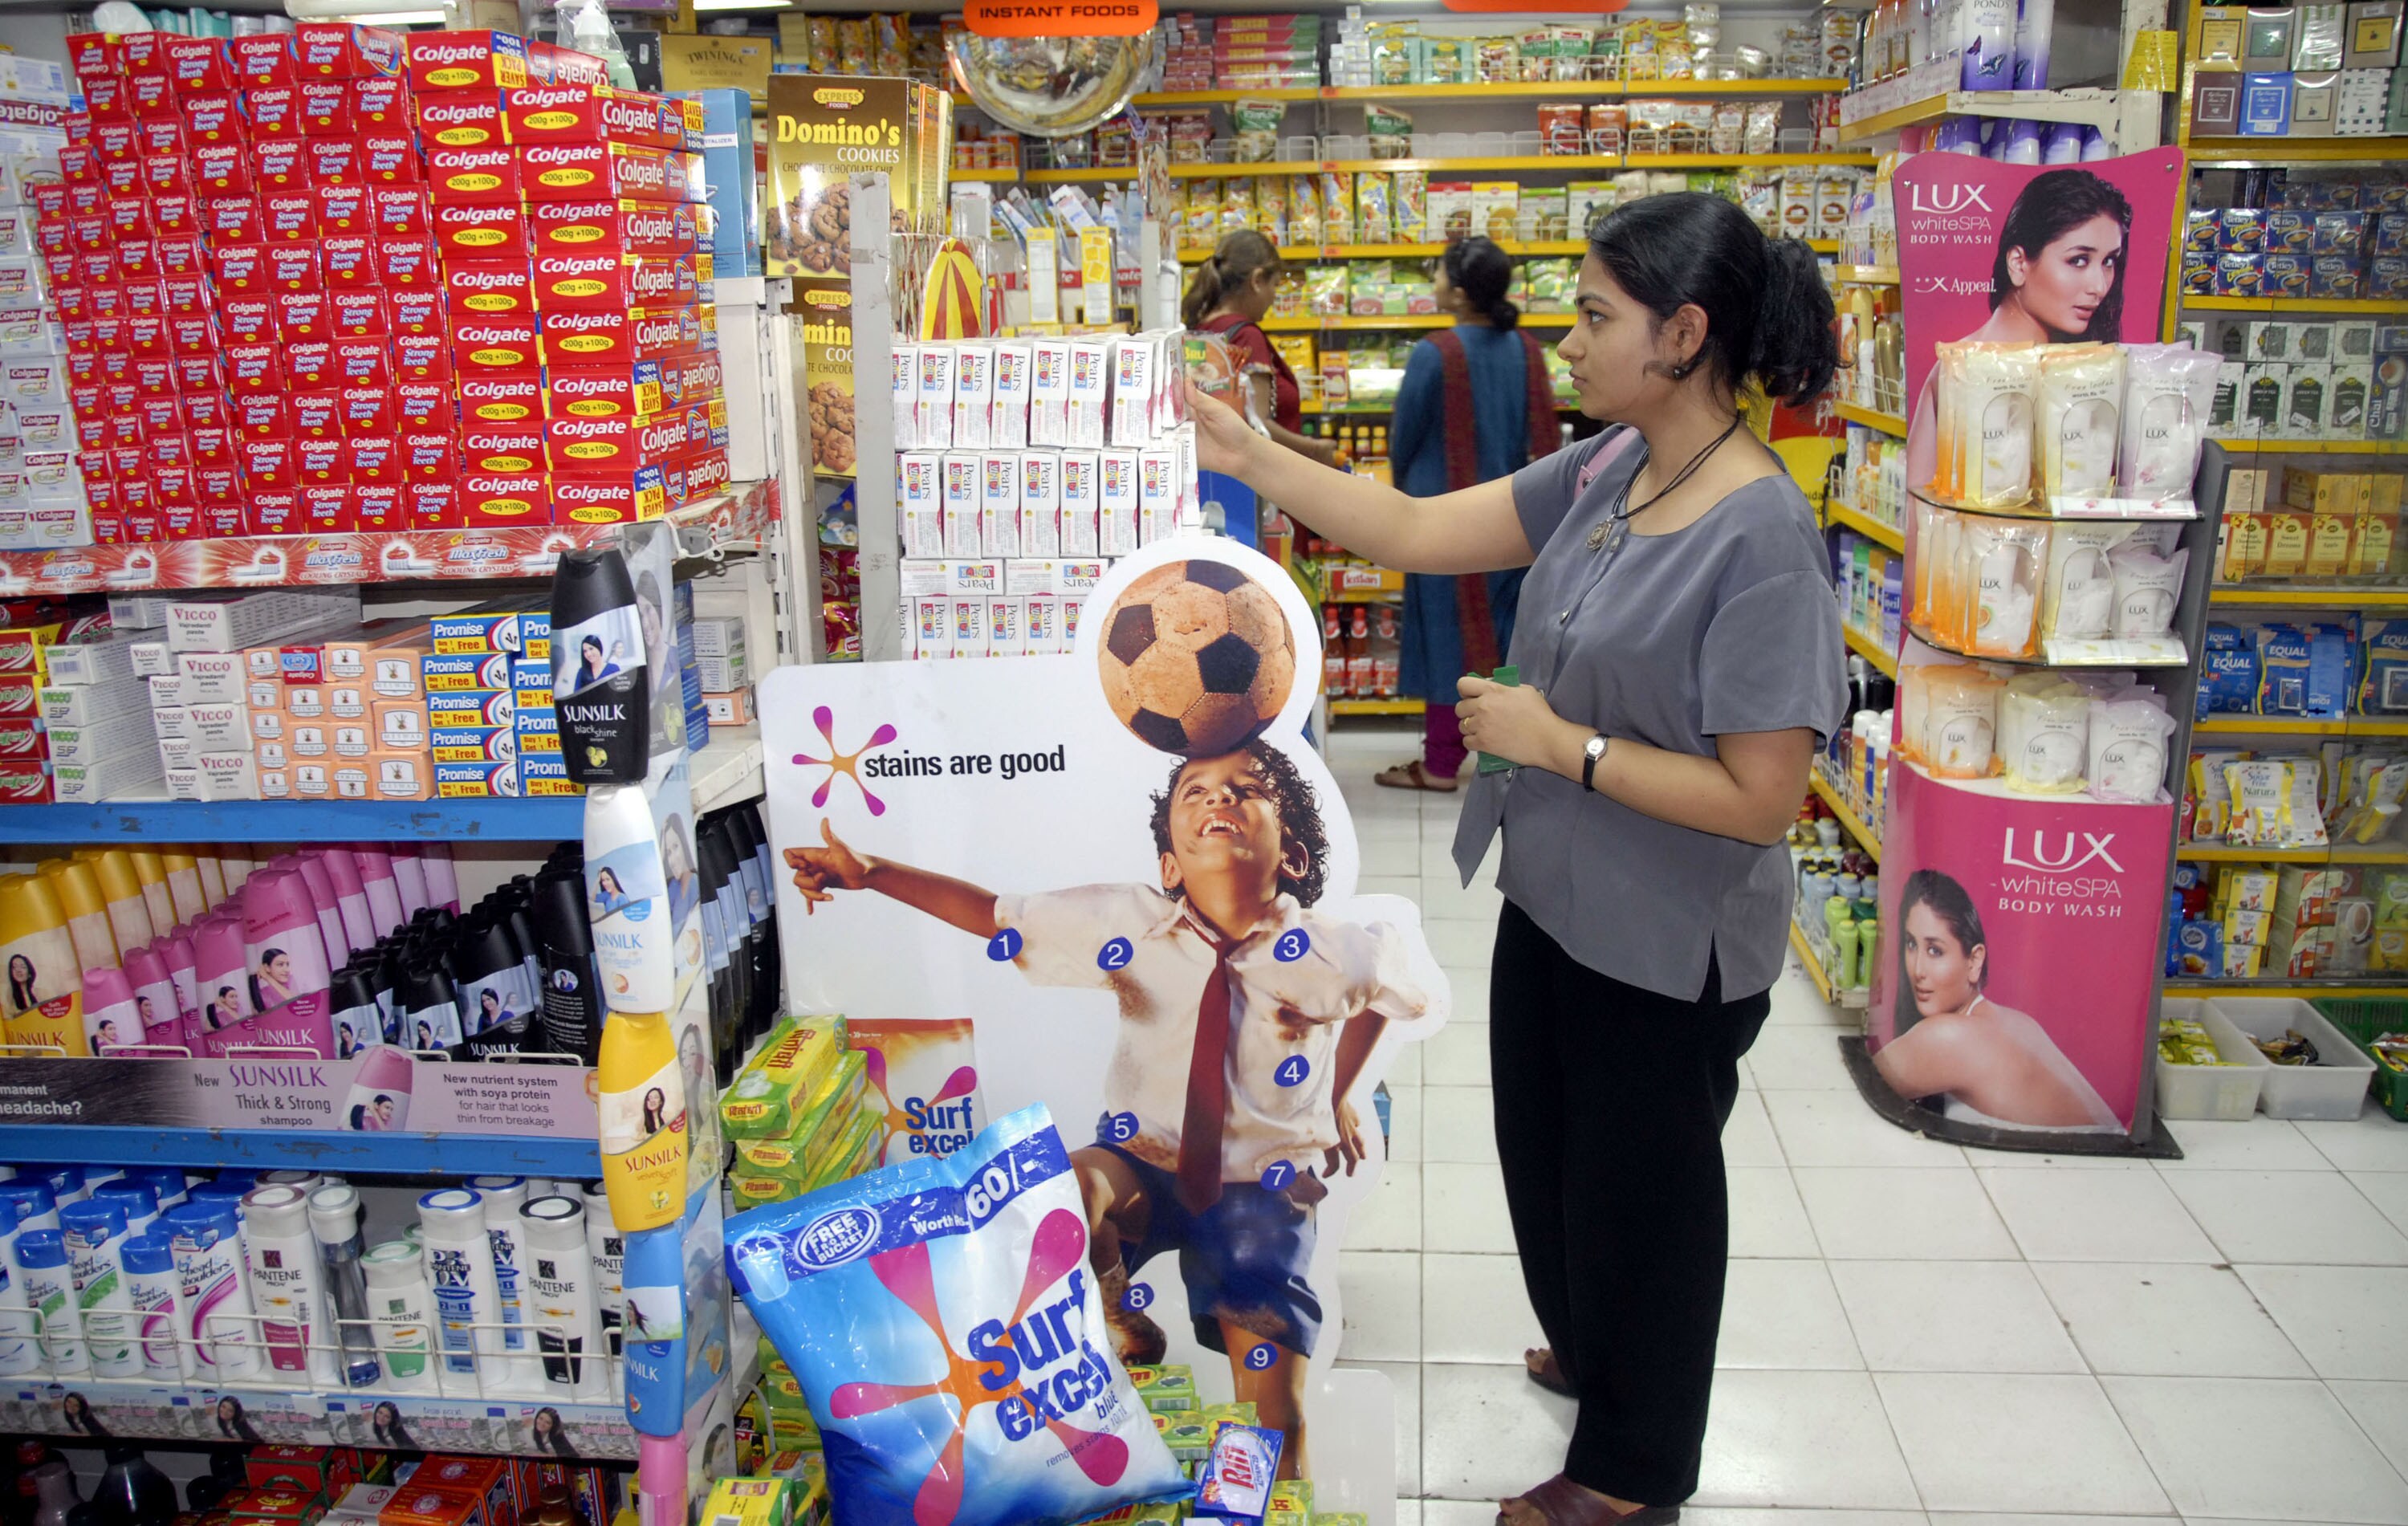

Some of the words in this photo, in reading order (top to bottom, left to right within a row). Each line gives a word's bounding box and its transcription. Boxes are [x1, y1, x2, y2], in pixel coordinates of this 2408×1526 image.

[980, 6, 1063, 18] INSTANT
[1071, 6, 1139, 16] FOODS
[171, 46, 212, 59] Colgate
[413, 45, 487, 63] Colgate
[179, 59, 208, 71] Strong
[178, 68, 203, 79] Teeth
[430, 72, 449, 81] 200g
[452, 71, 475, 81] +100g
[512, 88, 587, 107] Colgate
[817, 92, 859, 101] EXPRESS
[187, 98, 227, 111] Colgate
[685, 103, 702, 118] SAVER
[193, 112, 224, 122] Strong
[528, 116, 547, 125] 200g
[550, 115, 573, 124] +100g
[603, 100, 657, 132] Colgate
[663, 112, 683, 125] Strong
[687, 116, 702, 130] PACK
[193, 120, 218, 132] Teeth
[663, 124, 678, 135] Teeth
[777, 116, 900, 146] Domino's
[837, 148, 899, 164] COOKIES
[1912, 184, 1992, 214] LUX
[1911, 217, 1991, 231] whiteSPA
[2226, 216, 2250, 226] Tetley
[2273, 218, 2298, 228] Tetley
[1910, 234, 1948, 244] BODY
[1954, 235, 1991, 244] WASH
[2222, 261, 2246, 271] Tetley
[452, 271, 525, 288] Colgate
[1950, 278, 1996, 295] Appeal.
[469, 298, 486, 307] 200g
[490, 297, 512, 307] +100g
[808, 294, 848, 303] EXPRESS
[547, 314, 622, 331] Colgate
[563, 339, 583, 348] 200g
[585, 338, 609, 348] +100g
[340, 345, 380, 357] Colgate
[345, 358, 376, 369] Strong
[1052, 352, 1063, 389] Pears
[1134, 351, 1145, 388] Pears
[345, 367, 368, 377] Teeth
[937, 356, 948, 392] Pears
[641, 423, 687, 452] Colgate
[2146, 429, 2168, 438] LUX
[26, 453, 66, 466] Colgate
[688, 460, 728, 488] Colgate
[1120, 461, 1131, 497] Pears
[468, 478, 539, 494] Colgate
[254, 494, 292, 506] Colgate
[644, 489, 660, 503] PACK
[262, 507, 288, 517] Strong
[484, 503, 502, 511] 200g
[504, 503, 527, 512] +100g
[643, 503, 662, 517] SAVER
[261, 515, 283, 524] Teeth
[958, 580, 995, 590] Pears
[1980, 579, 2000, 588] LUX
[173, 608, 217, 621] VICCO
[2129, 606, 2149, 614] LUX
[972, 604, 981, 640] Pears
[434, 623, 484, 637] Promise
[2209, 634, 2234, 642] EQUAL
[458, 641, 480, 650] Free
[2269, 645, 2307, 657] EQUAL
[2213, 658, 2251, 670] EQUAL
[191, 710, 233, 721] VICCO
[564, 704, 626, 722] SUNSILK
[575, 725, 594, 735] black
[595, 729, 617, 737] shine
[201, 758, 243, 769] VICCO
[864, 750, 942, 778] stains
[950, 753, 992, 775] are
[1000, 745, 1065, 780] good
[2105, 754, 2125, 763] LUX
[438, 768, 484, 780] Promise
[460, 785, 481, 794] Free
[553, 783, 577, 793] Free
[2243, 786, 2276, 796] Natura
[2003, 828, 2125, 873] LUX
[2001, 877, 2121, 898] whiteSPA
[1999, 898, 2056, 914] BODY
[2064, 903, 2121, 918] WASH
[999, 935, 1010, 956] 1
[1283, 935, 1300, 957] 3
[1107, 944, 1124, 966] 2
[256, 1028, 315, 1044] SUNSILK
[194, 1074, 219, 1087] New
[230, 1064, 327, 1087] SUNSILK
[1283, 1061, 1300, 1082] 4
[443, 1073, 466, 1083] New
[471, 1075, 514, 1084] nutrient
[517, 1076, 557, 1089] system
[0, 1085, 48, 1095] manent
[454, 1087, 478, 1097] with
[481, 1090, 507, 1100] soya
[511, 1089, 550, 1101] protein
[234, 1094, 268, 1109] Thick
[275, 1097, 286, 1109] &
[290, 1097, 331, 1114] Strong
[459, 1101, 473, 1109] for
[476, 1101, 496, 1111] hair
[498, 1101, 519, 1112] that
[521, 1102, 549, 1113] looks
[904, 1097, 972, 1130] Surf
[260, 1116, 312, 1127] shampoo
[458, 1114, 476, 1123] thin
[479, 1115, 502, 1125] from
[506, 1116, 555, 1128] breakage
[1114, 1118, 1130, 1138] 5
[909, 1130, 973, 1154] excel
[625, 1146, 681, 1173] SUNSILK
[1270, 1166, 1286, 1186] 7
[745, 1182, 779, 1192] Pitambari
[912, 1215, 954, 1235] Worth
[966, 1153, 1036, 1219] 60/-
[807, 1212, 857, 1246] FREE
[816, 1220, 859, 1255] FROSTY
[817, 1229, 864, 1264] BUCKET
[254, 1268, 301, 1281] PANTENE
[529, 1278, 575, 1292] PANTENE
[1130, 1288, 1145, 1308] 8
[968, 1268, 1086, 1392] Surf
[1253, 1348, 1268, 1366] 9
[995, 1335, 1112, 1442] excel
[1095, 1390, 1118, 1419] blue
[1046, 1443, 1084, 1467] removes
[1086, 1424, 1109, 1447] stains
[1217, 1446, 1255, 1489] Rin
